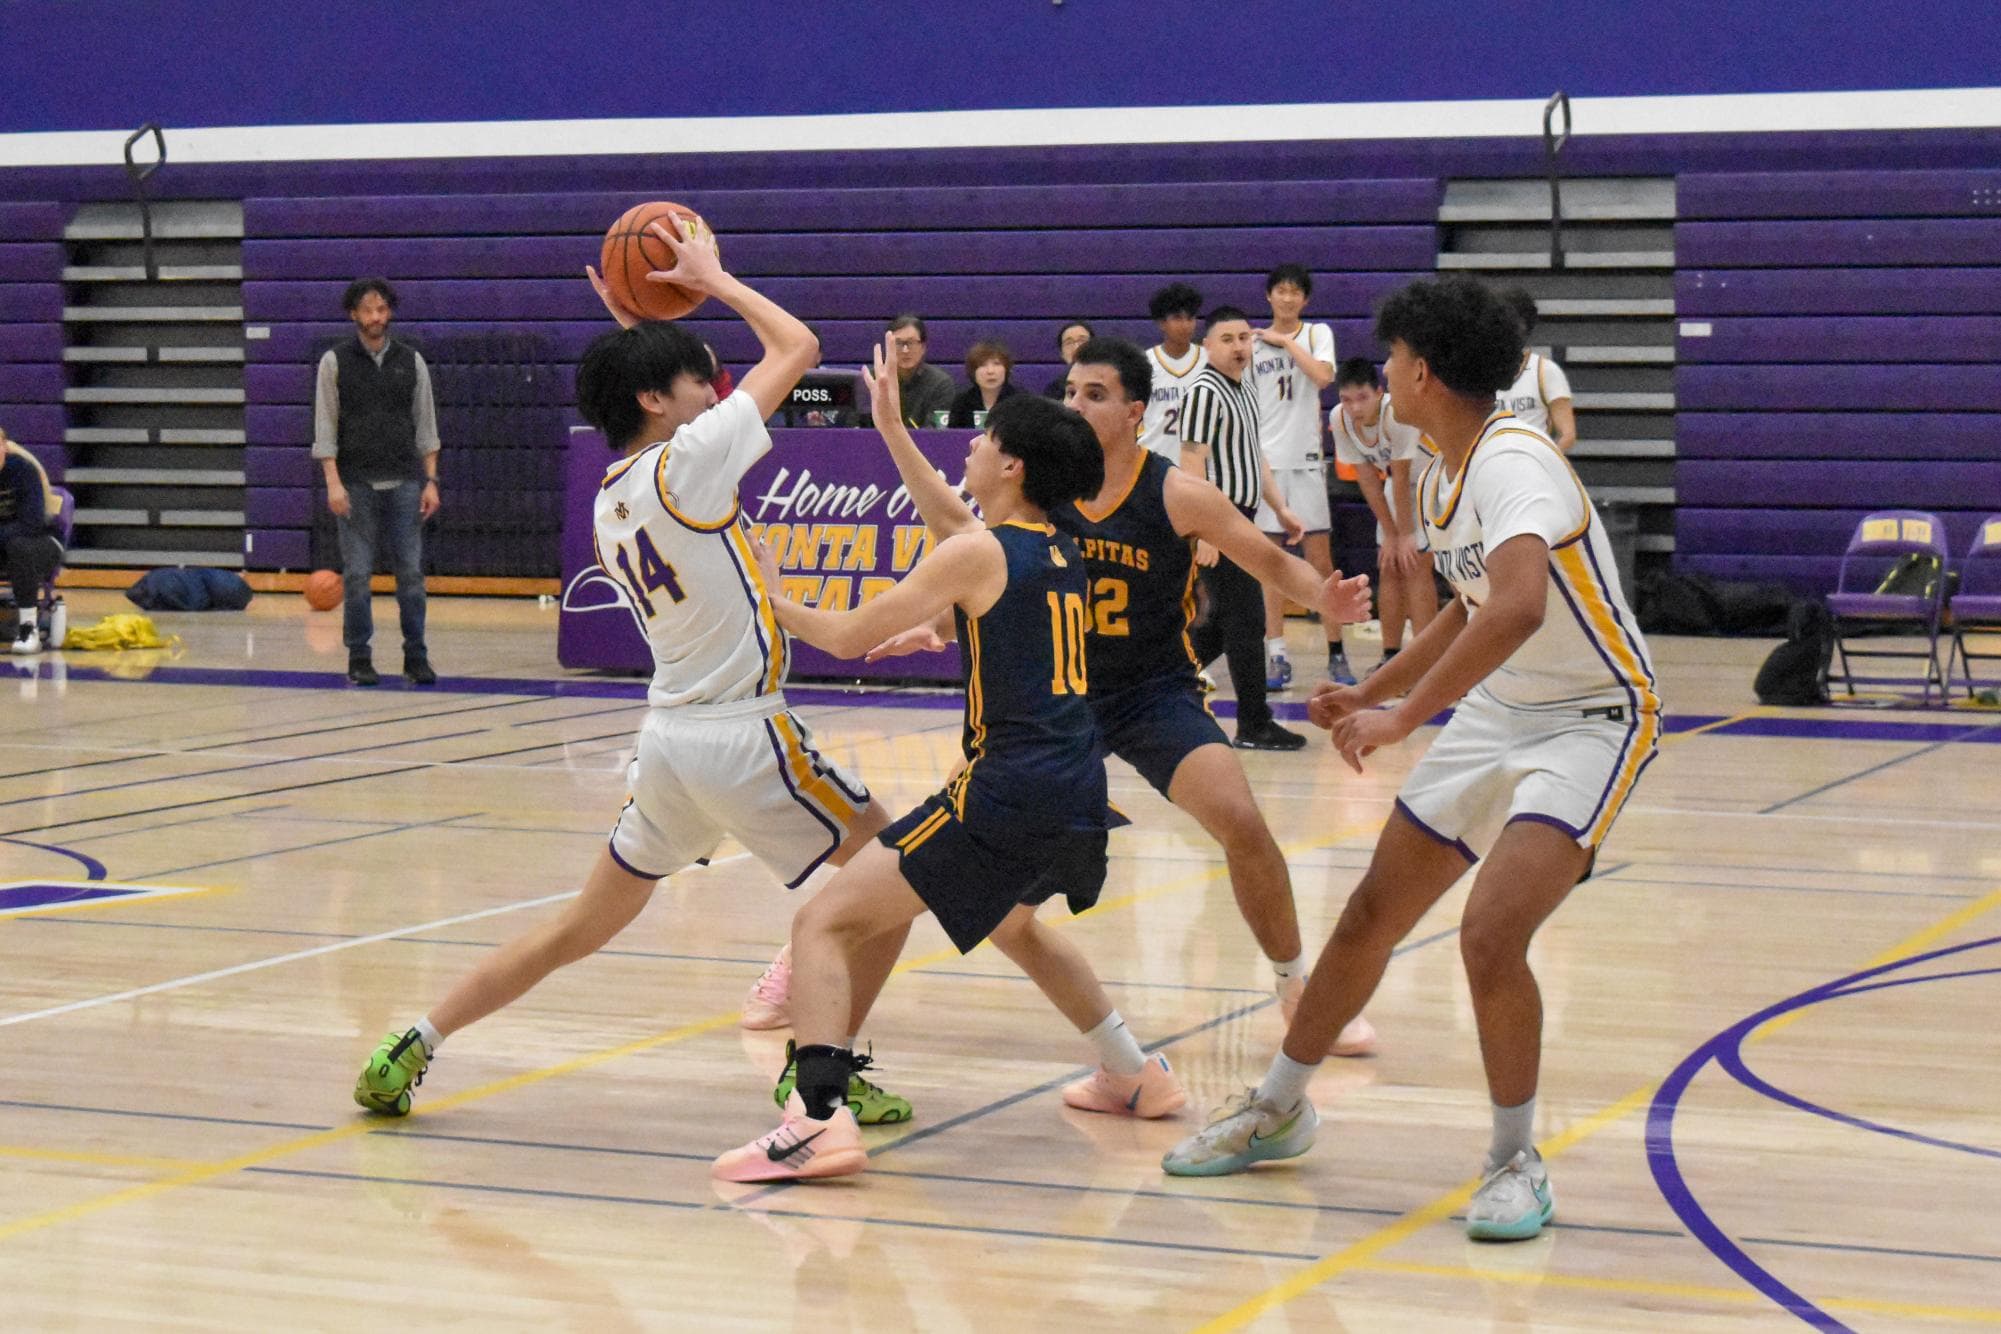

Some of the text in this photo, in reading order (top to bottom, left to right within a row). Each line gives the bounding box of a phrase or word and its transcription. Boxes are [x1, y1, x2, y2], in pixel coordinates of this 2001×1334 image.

[1255, 357, 1284, 375] MONTA
[793, 389, 832, 402] POSS.
[1163, 408, 1181, 435] 2
[756, 467, 887, 521] Home
[616, 525, 688, 619] 14
[1073, 537, 1150, 572] PITAS
[1084, 577, 1130, 637] 2
[1047, 591, 1088, 695] 10
